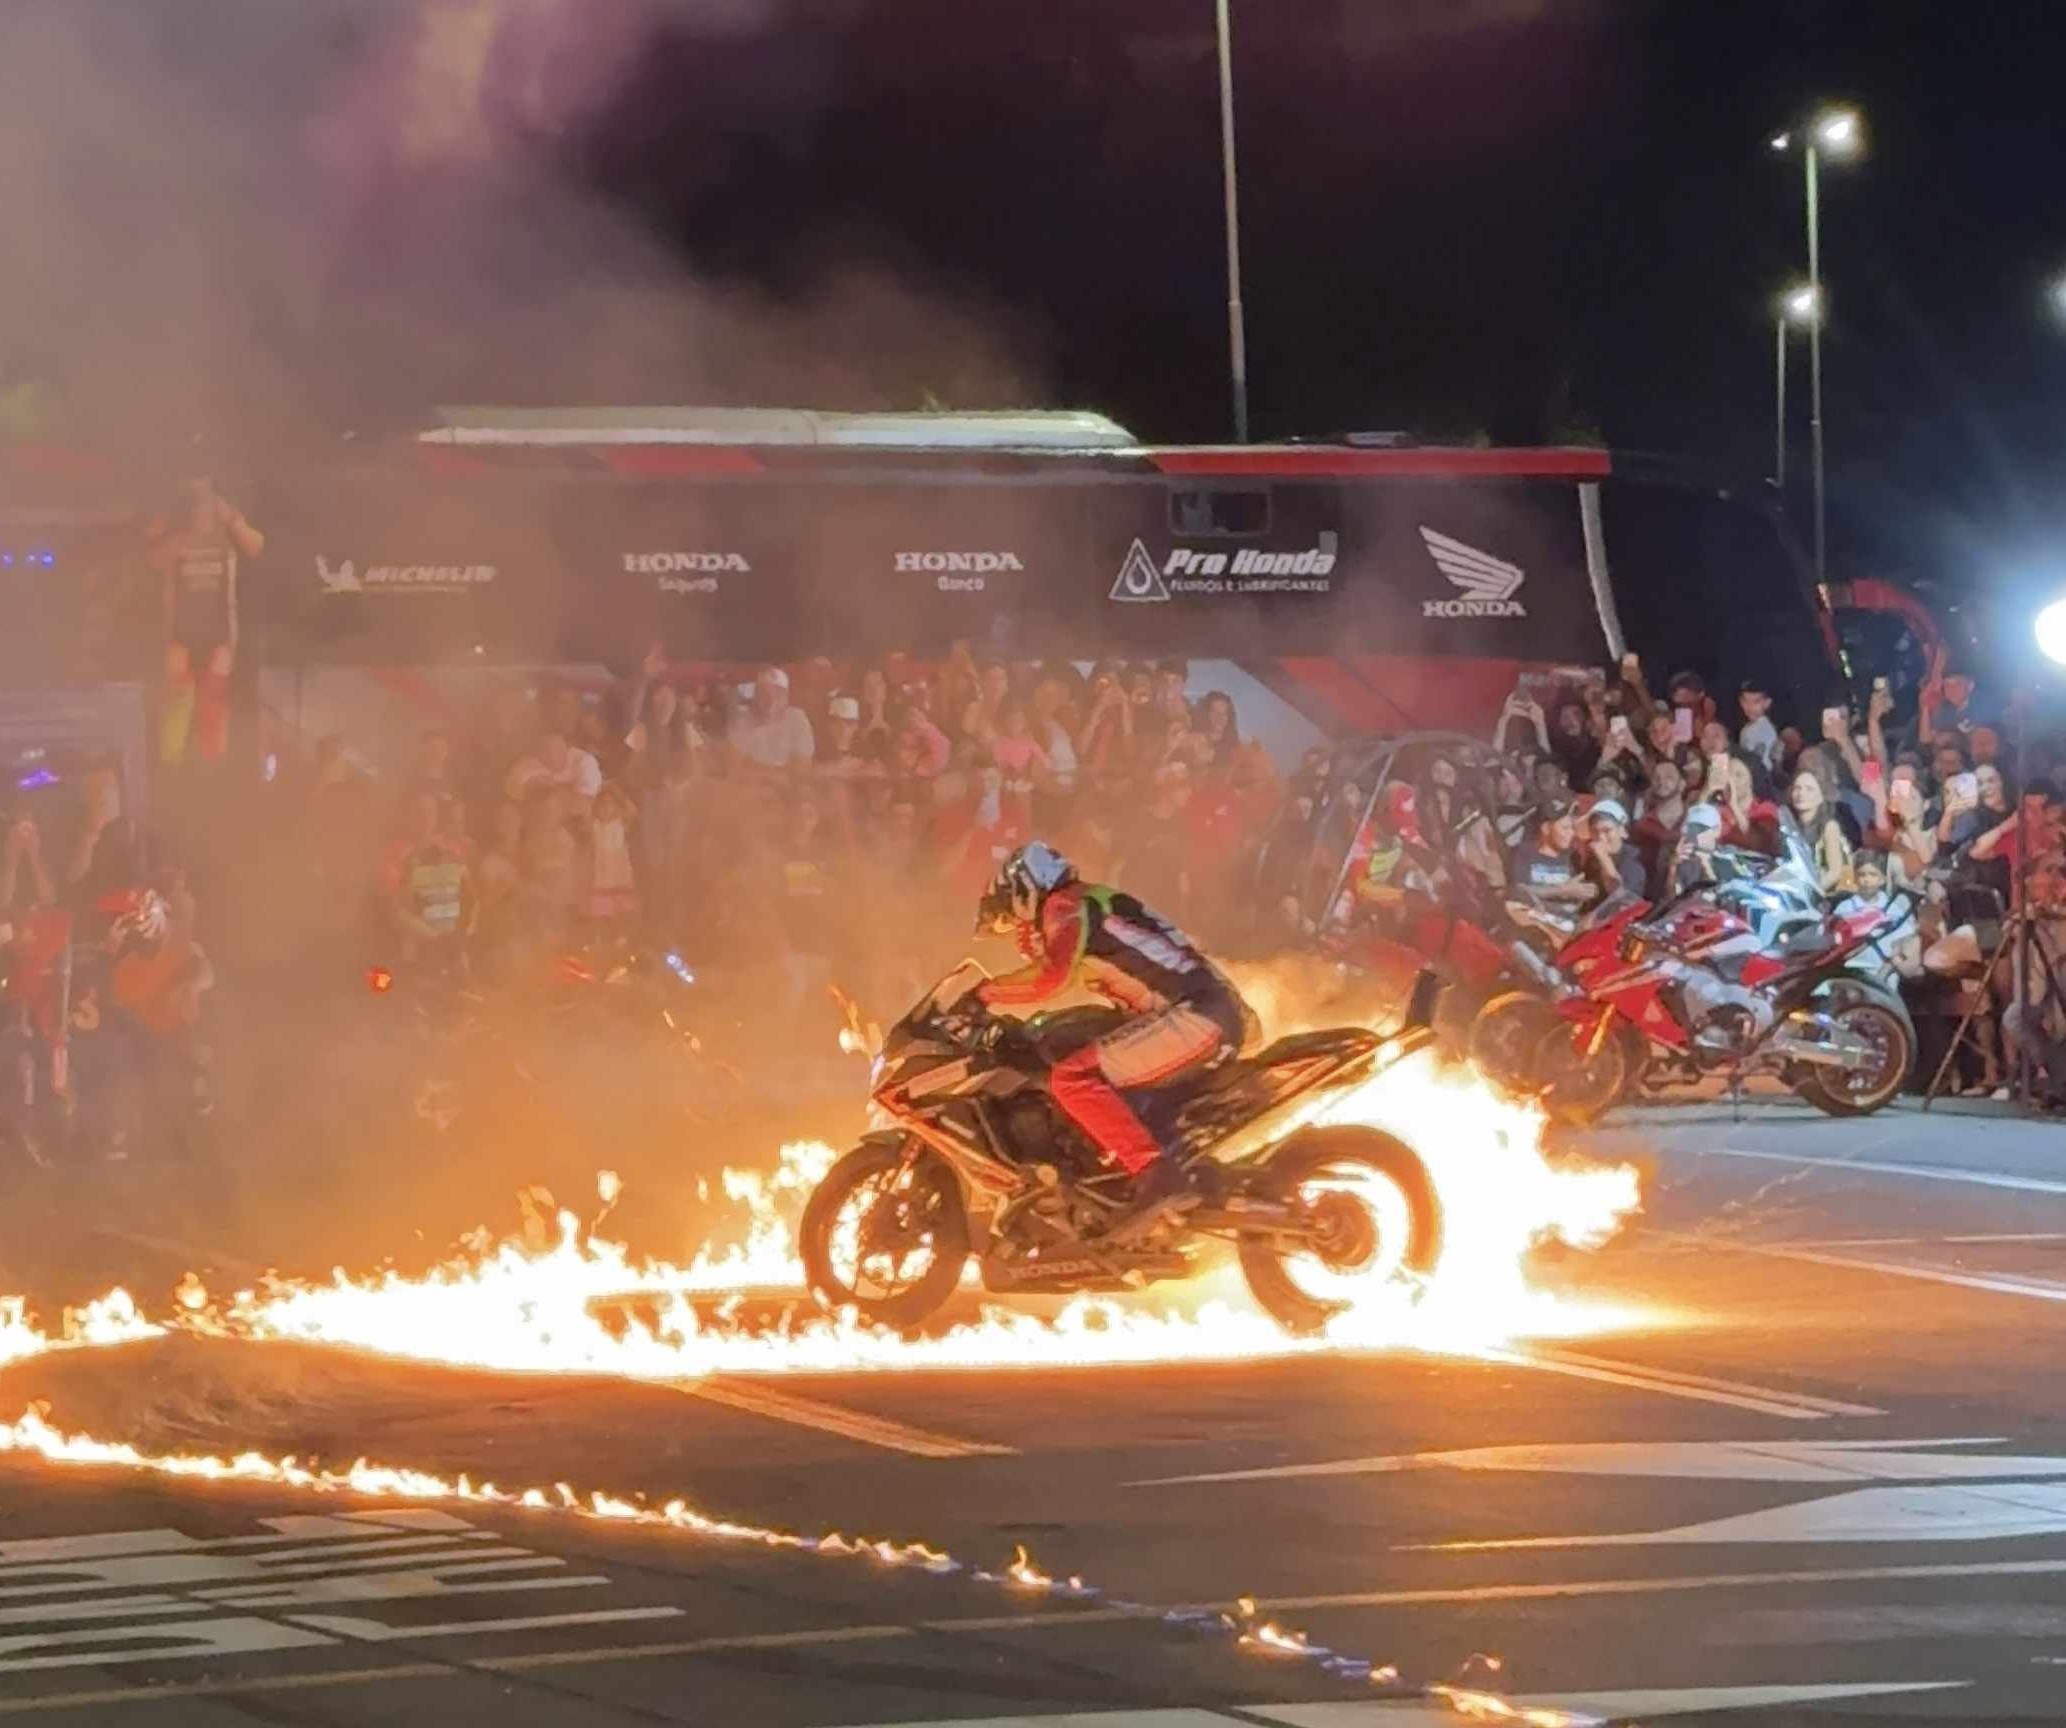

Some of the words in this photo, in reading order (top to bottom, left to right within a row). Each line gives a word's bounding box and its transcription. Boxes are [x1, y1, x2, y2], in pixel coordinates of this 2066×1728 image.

[622, 552, 751, 571] HONDA
[893, 552, 1024, 571] HONDA
[1163, 549, 1227, 575] Pro
[1230, 549, 1336, 575] Honda
[1422, 600, 1527, 617] HONDA
[1007, 1260, 1099, 1280] HONDA
